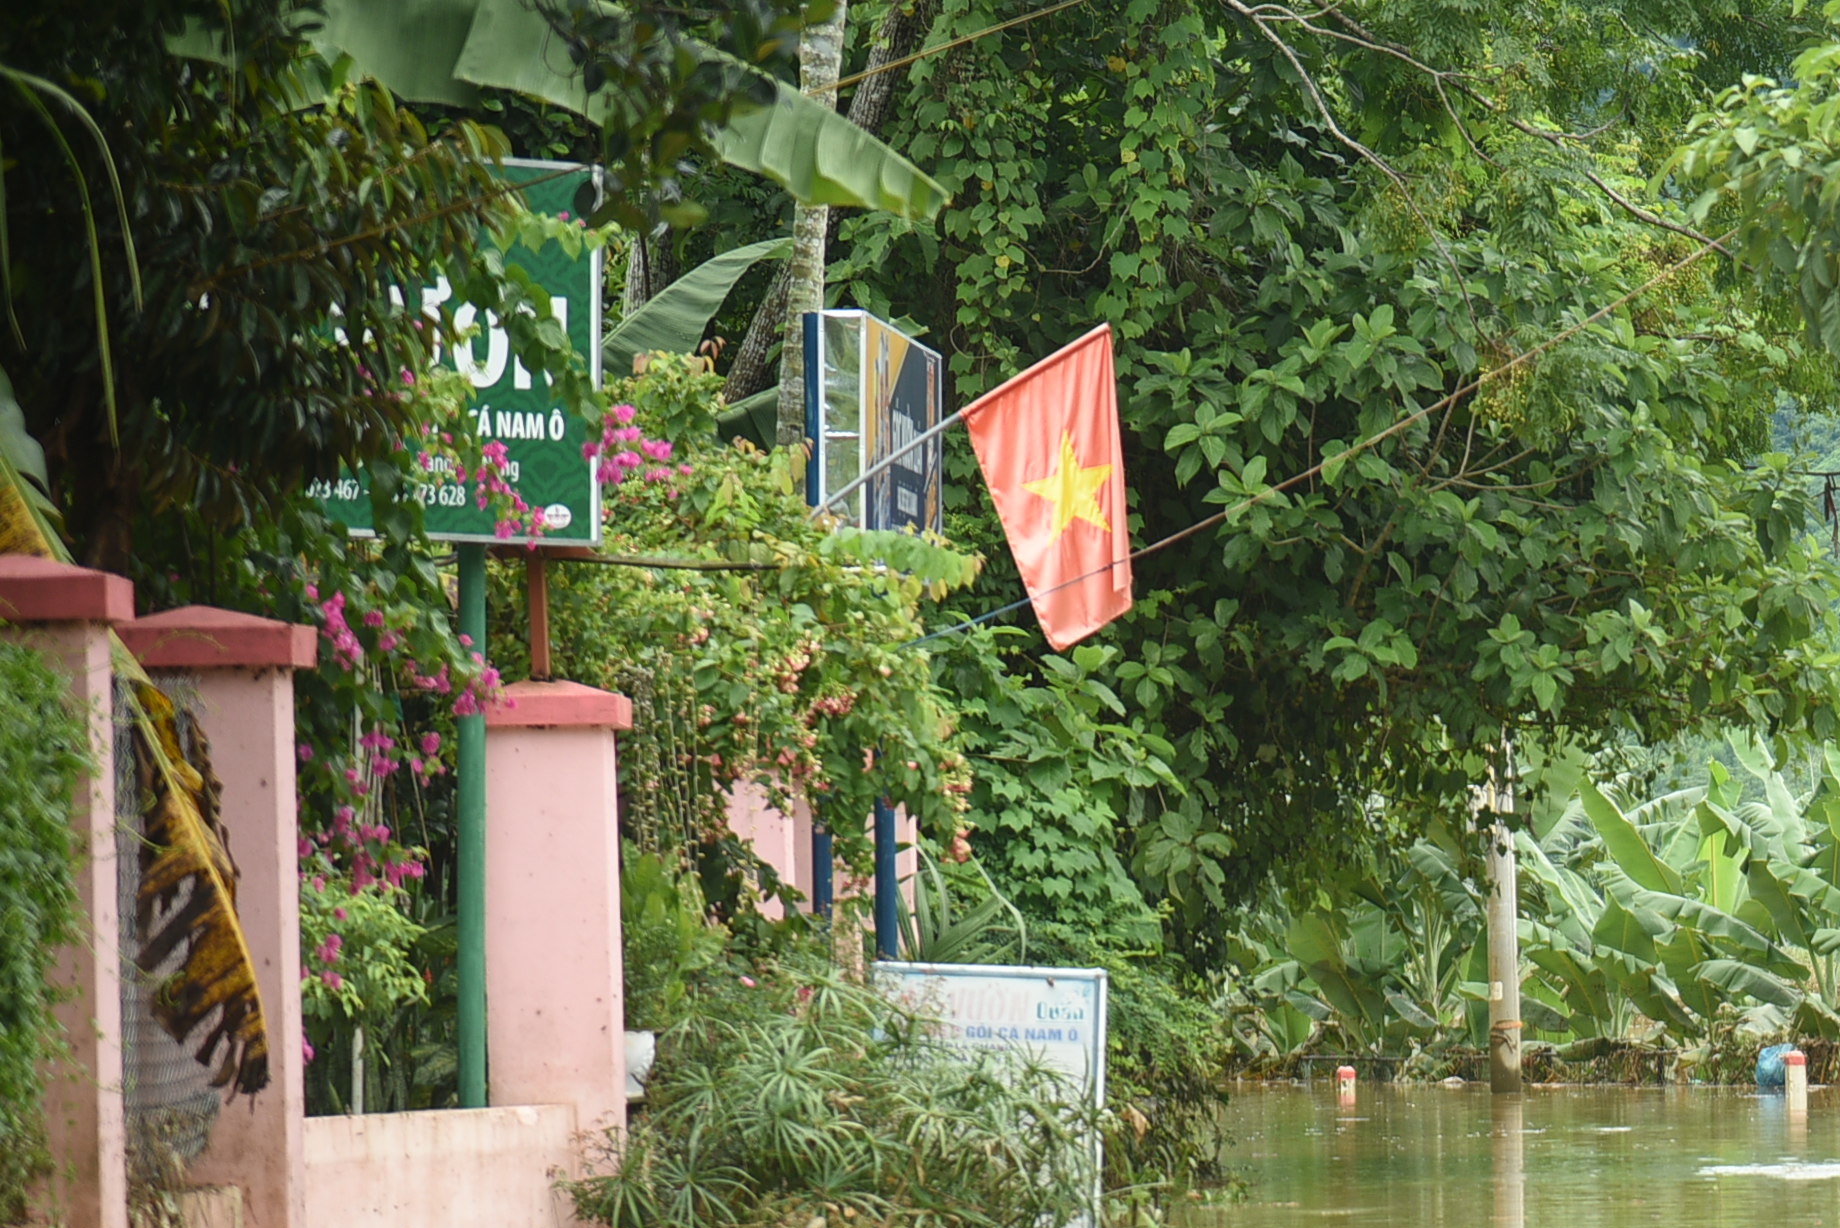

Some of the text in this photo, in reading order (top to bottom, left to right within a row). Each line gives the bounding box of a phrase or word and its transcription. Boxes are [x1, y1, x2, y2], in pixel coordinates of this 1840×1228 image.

[468, 403, 566, 442] Á NAM Ô
[438, 485, 466, 507] 628
[1024, 1027, 1063, 1042] NAM
